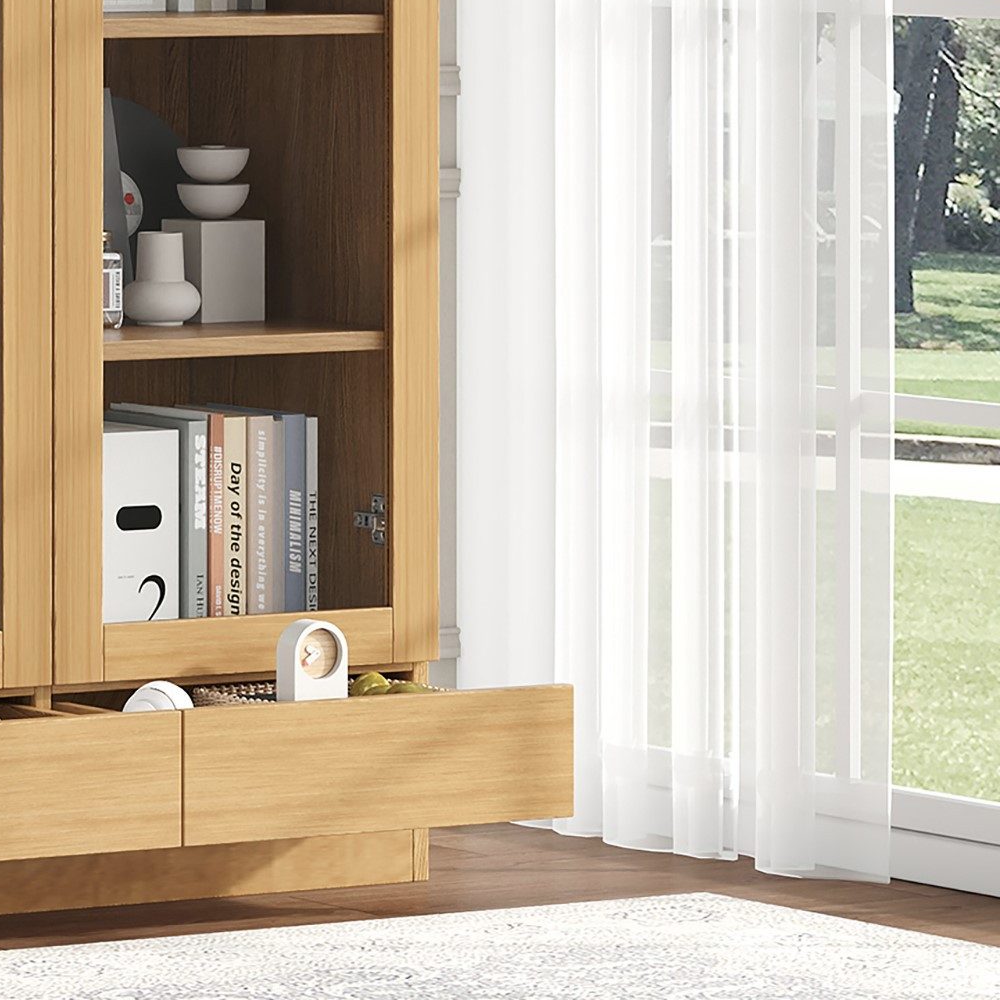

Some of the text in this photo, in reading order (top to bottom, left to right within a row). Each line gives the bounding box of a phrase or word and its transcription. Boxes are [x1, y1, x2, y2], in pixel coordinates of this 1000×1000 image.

[194, 434, 207, 530] STEAM
[213, 445, 223, 535] #DISRUPTMENOW
[309, 492, 317, 521] THE
[227, 461, 243, 616] Day of the design
[288, 489, 302, 574] MINIMALISM
[309, 526, 317, 567] NEXT
